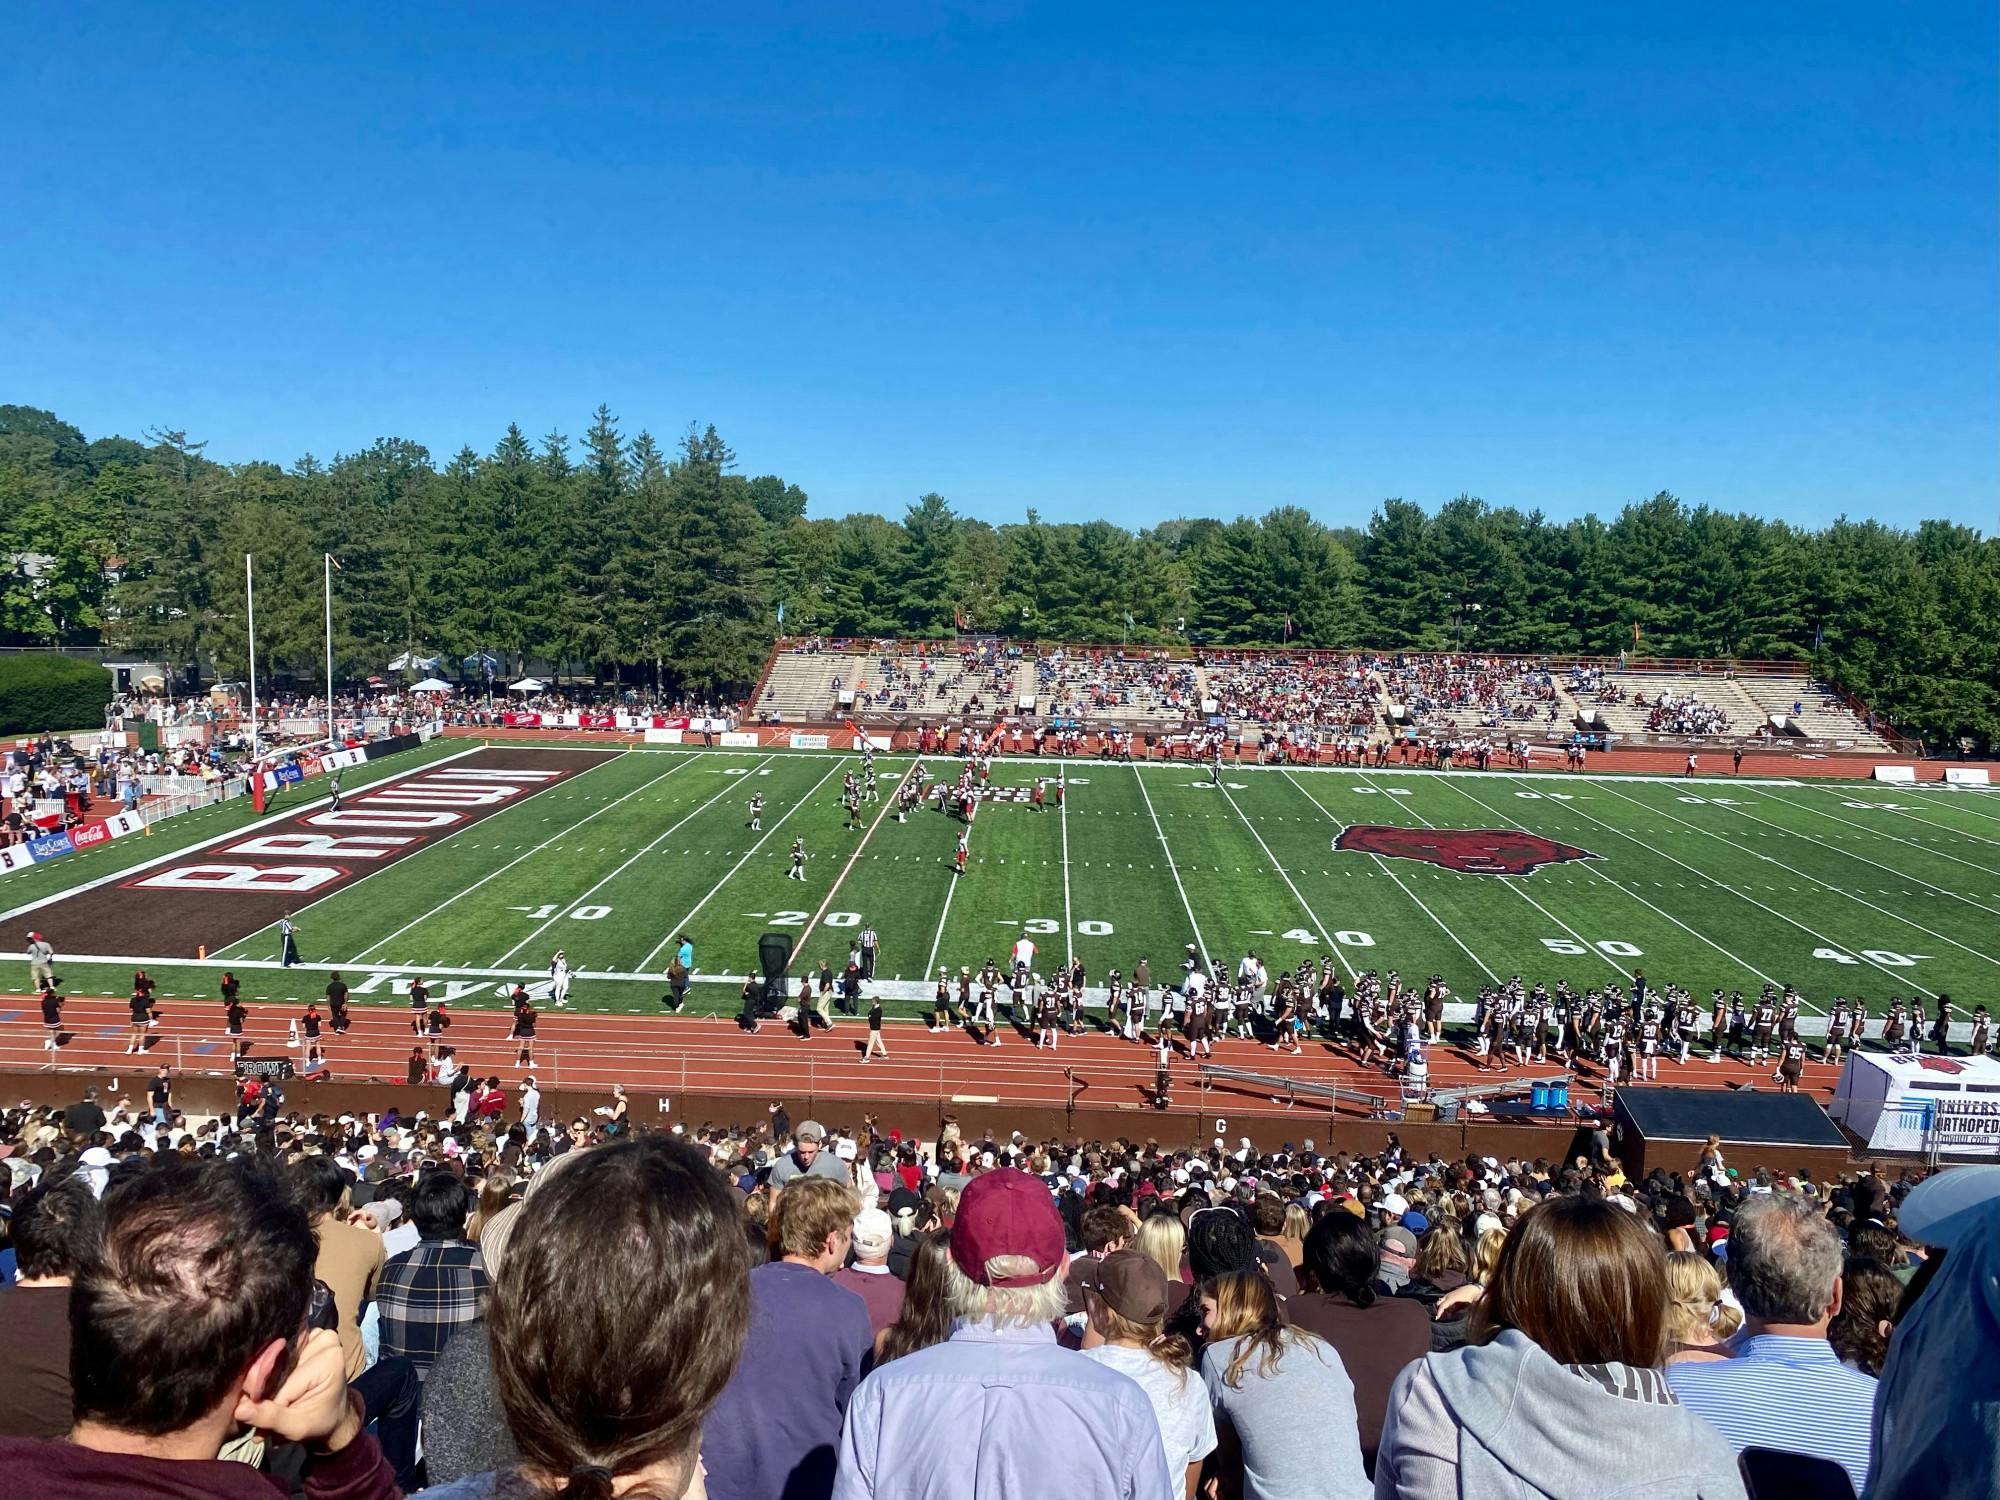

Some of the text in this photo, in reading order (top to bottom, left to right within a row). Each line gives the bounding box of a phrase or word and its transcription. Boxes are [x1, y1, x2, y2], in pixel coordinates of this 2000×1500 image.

[557, 715, 564, 724] B
[631, 717, 638, 726] B
[119, 818, 130, 832] B
[119, 767, 572, 893] BROWN
[74, 825, 104, 846] Coca-Cola
[1, 852, 14, 869] B
[987, 972, 994, 982] 7
[1020, 975, 1027, 986] 0
[1058, 978, 1066, 989] 5
[1046, 997, 1056, 1009] 31
[1761, 1008, 1773, 1021] 77
[1786, 1007, 1798, 1019] 27
[1523, 1014, 1536, 1026] 29
[1643, 1025, 1656, 1037] 20
[1788, 1046, 1803, 1060] 95
[107, 1077, 120, 1092] J
[658, 1098, 670, 1113] H
[1215, 1118, 1227, 1133] G
